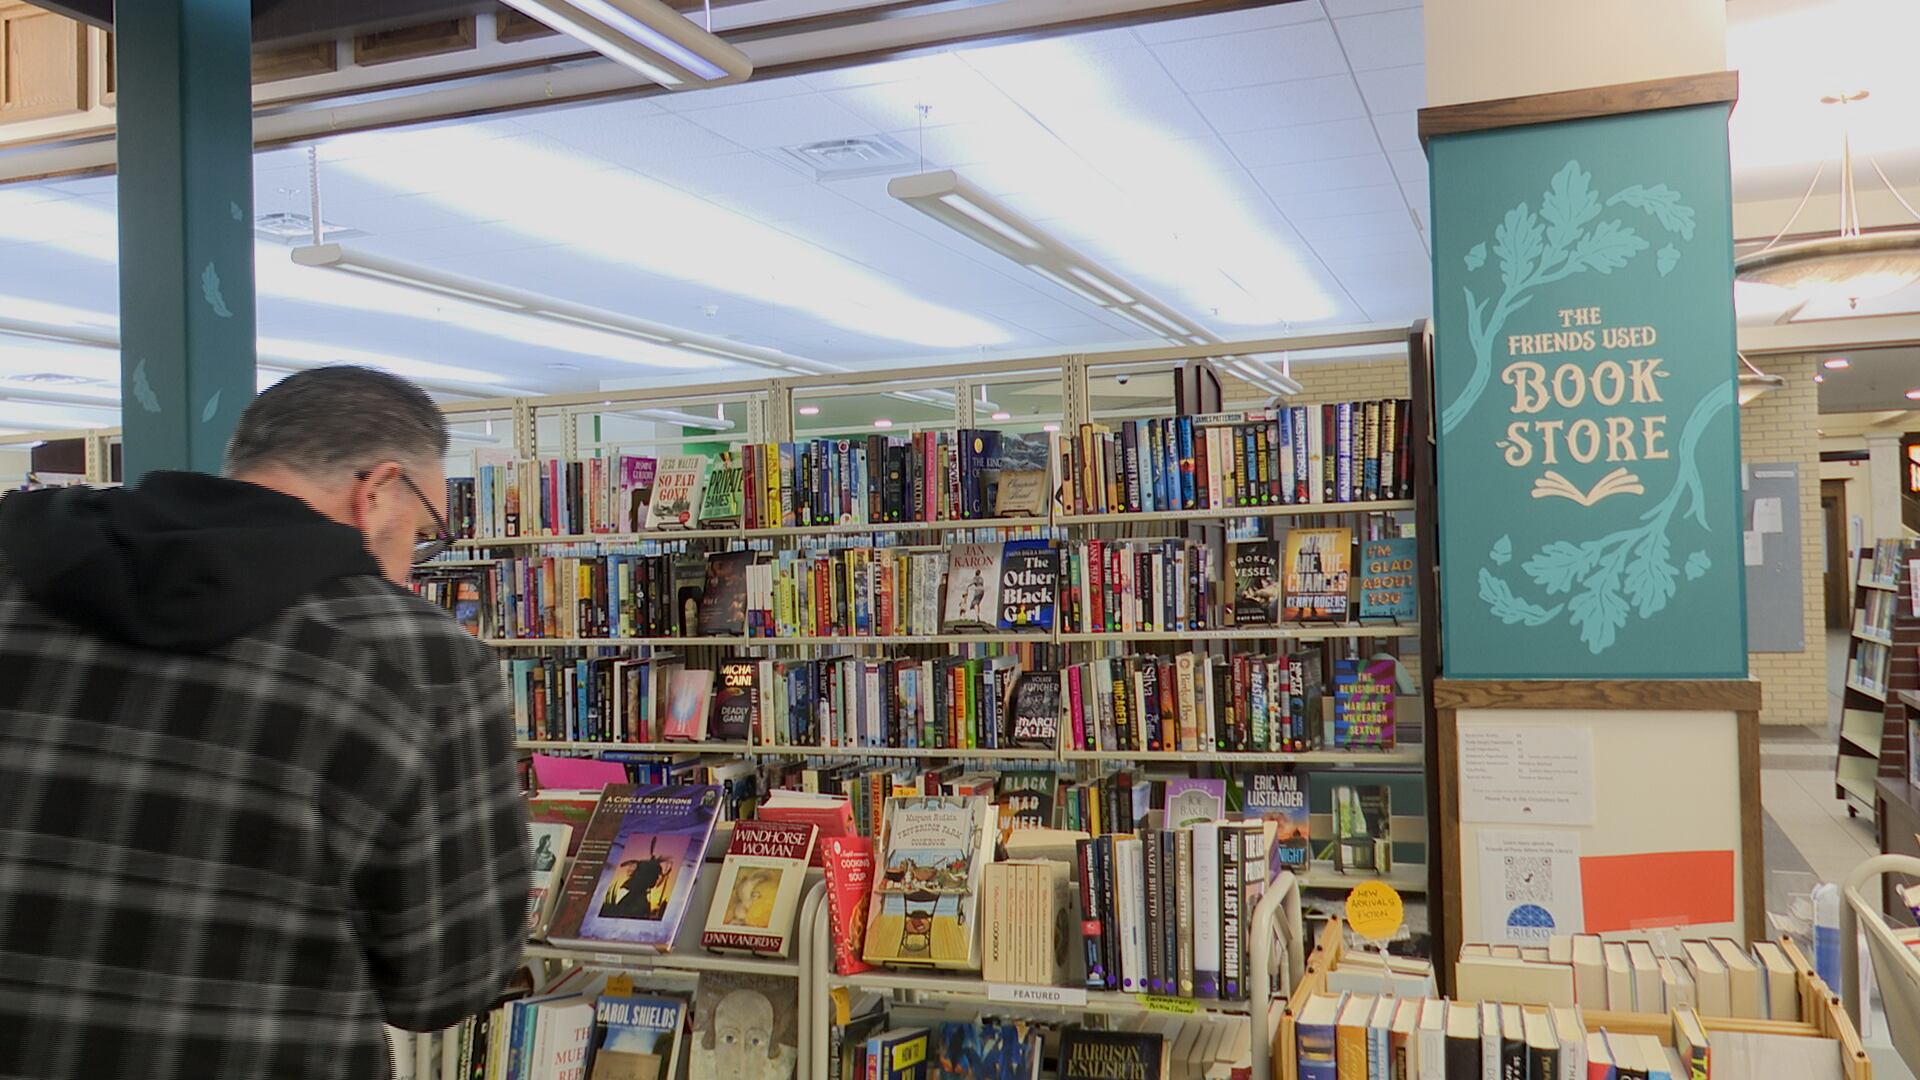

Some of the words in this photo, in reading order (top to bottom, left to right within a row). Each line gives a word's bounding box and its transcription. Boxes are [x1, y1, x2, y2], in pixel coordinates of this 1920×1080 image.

[1558, 307, 1601, 327] THE
[1508, 329, 1595, 355] FRIENDS
[1602, 326, 1657, 348] USED
[1501, 358, 1670, 413] BOOK
[1195, 416, 1212, 424] JAMES
[1213, 413, 1242, 422] PATTERSON
[1294, 409, 1305, 436] JAMES
[1496, 415, 1669, 466] STORE
[1295, 435, 1307, 481] PATTERSON
[658, 475, 672, 488] SO
[674, 473, 695, 487] FAR
[659, 488, 689, 501] GONE
[705, 494, 730, 509] GAMES
[965, 545, 985, 555] JAN
[1301, 534, 1339, 553] WHAT
[1367, 545, 1391, 558] I'M
[954, 556, 994, 568] KARON
[1024, 557, 1049, 568] The
[1229, 555, 1277, 568] BROKEN
[1293, 554, 1318, 573] ARE
[1321, 553, 1344, 573] THE
[1370, 560, 1412, 573] GLAD
[1003, 570, 1056, 586] Other
[1090, 564, 1100, 585] PERRY
[1233, 567, 1272, 577] VESSEL
[1287, 572, 1348, 592] CHANCES
[1361, 575, 1412, 590] ABOUT
[1003, 587, 1053, 604] Black
[1286, 596, 1313, 608] KENNY
[1313, 595, 1347, 608] ROGERS
[1367, 592, 1401, 606] YOU
[720, 664, 752, 675] MICHA
[1142, 666, 1157, 696] Silva
[1251, 673, 1263, 697] BEAST
[1339, 684, 1391, 694] REVISIONERS
[1113, 680, 1126, 724] UNCAGED
[1343, 702, 1386, 711] MARGARET
[721, 706, 749, 714] DEADLY
[723, 715, 745, 723] GAME
[1343, 713, 1388, 723] WILKERSON
[1350, 726, 1381, 736] SEXTON
[1005, 776, 1048, 791] BLACK
[1254, 775, 1274, 790] ERIC
[1276, 776, 1297, 791] VAN
[613, 796, 643, 804] CIRCLE
[656, 797, 692, 805] NATIONS
[1009, 795, 1039, 810] MAD
[1247, 790, 1303, 808] LUSTBADER
[735, 829, 806, 846] WINDHORSE
[741, 843, 794, 857] WOMAN
[1148, 833, 1157, 875] BENAZIR
[841, 859, 870, 868] COOKING
[848, 873, 867, 882] SOUP
[1224, 867, 1237, 889] THE
[1149, 877, 1157, 917] BHUTTO
[1200, 864, 1209, 941] EVICTED
[1224, 890, 1238, 916] LAST
[703, 933, 728, 944] LYNN
[735, 936, 781, 948] ANDREWS
[1224, 918, 1239, 978] POLITICIAN
[1013, 990, 1061, 1001] FEATURED
[597, 1002, 630, 1023] CAROL
[631, 1005, 677, 1028] SHIELDS
[575, 1027, 591, 1041] TH
[1072, 1043, 1141, 1062] HARRISON
